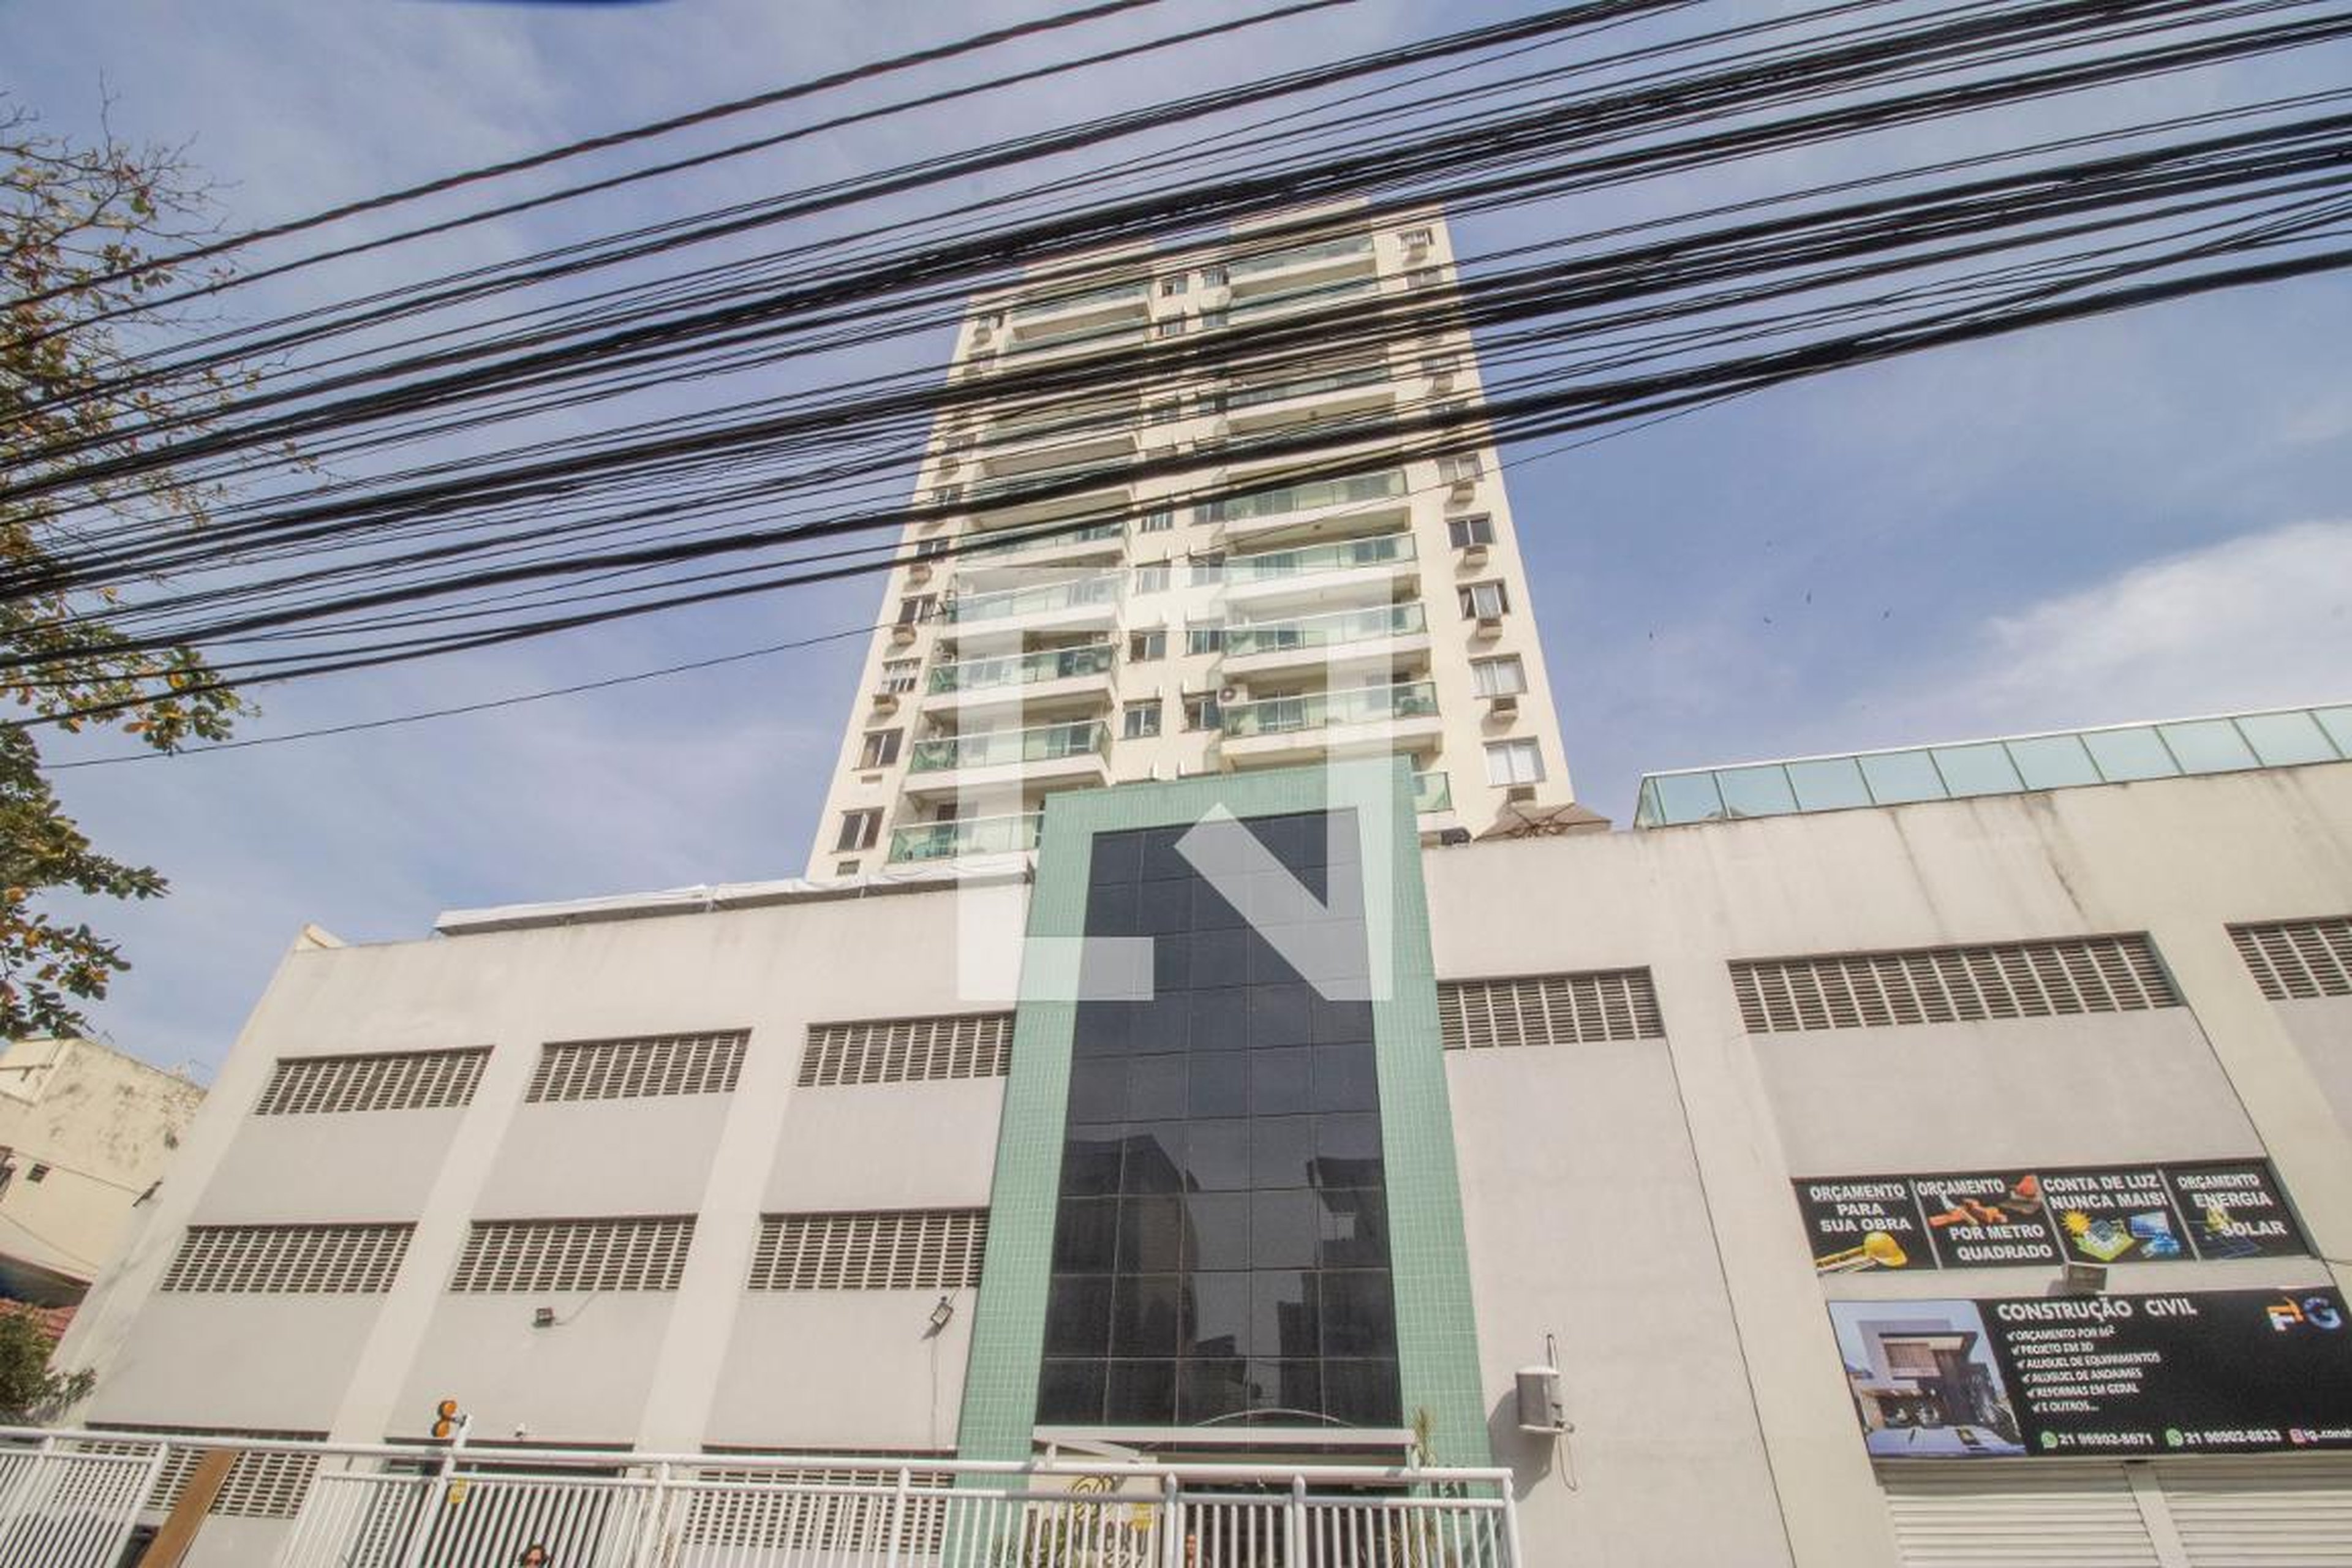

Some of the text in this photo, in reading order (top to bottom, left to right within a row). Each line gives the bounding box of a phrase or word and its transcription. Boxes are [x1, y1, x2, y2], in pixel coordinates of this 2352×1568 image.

[1918, 1178, 2006, 1197] ORÇAMENTO
[2043, 1174, 2161, 1192] CONTA DE LUZ
[2177, 1172, 2260, 1191] ORÇAMENTO
[1810, 1183, 1906, 1202] ORÇAMENTO
[2049, 1193, 2115, 1209] NUNCA
[2193, 1191, 2272, 1208] ENERGIA
[1837, 1202, 1885, 1216] PARA
[1820, 1216, 1912, 1232] SUA OBRA
[1949, 1223, 2045, 1241] POR METRO
[2222, 1220, 2287, 1237] SOLAR
[1957, 1243, 2052, 1261] QUADRADO
[1998, 1297, 2197, 1322] CONSTRUÇÃO CIVIL
[2016, 1329, 2076, 1341] ORÇAMENTO
[2078, 1328, 2097, 1338] POR
